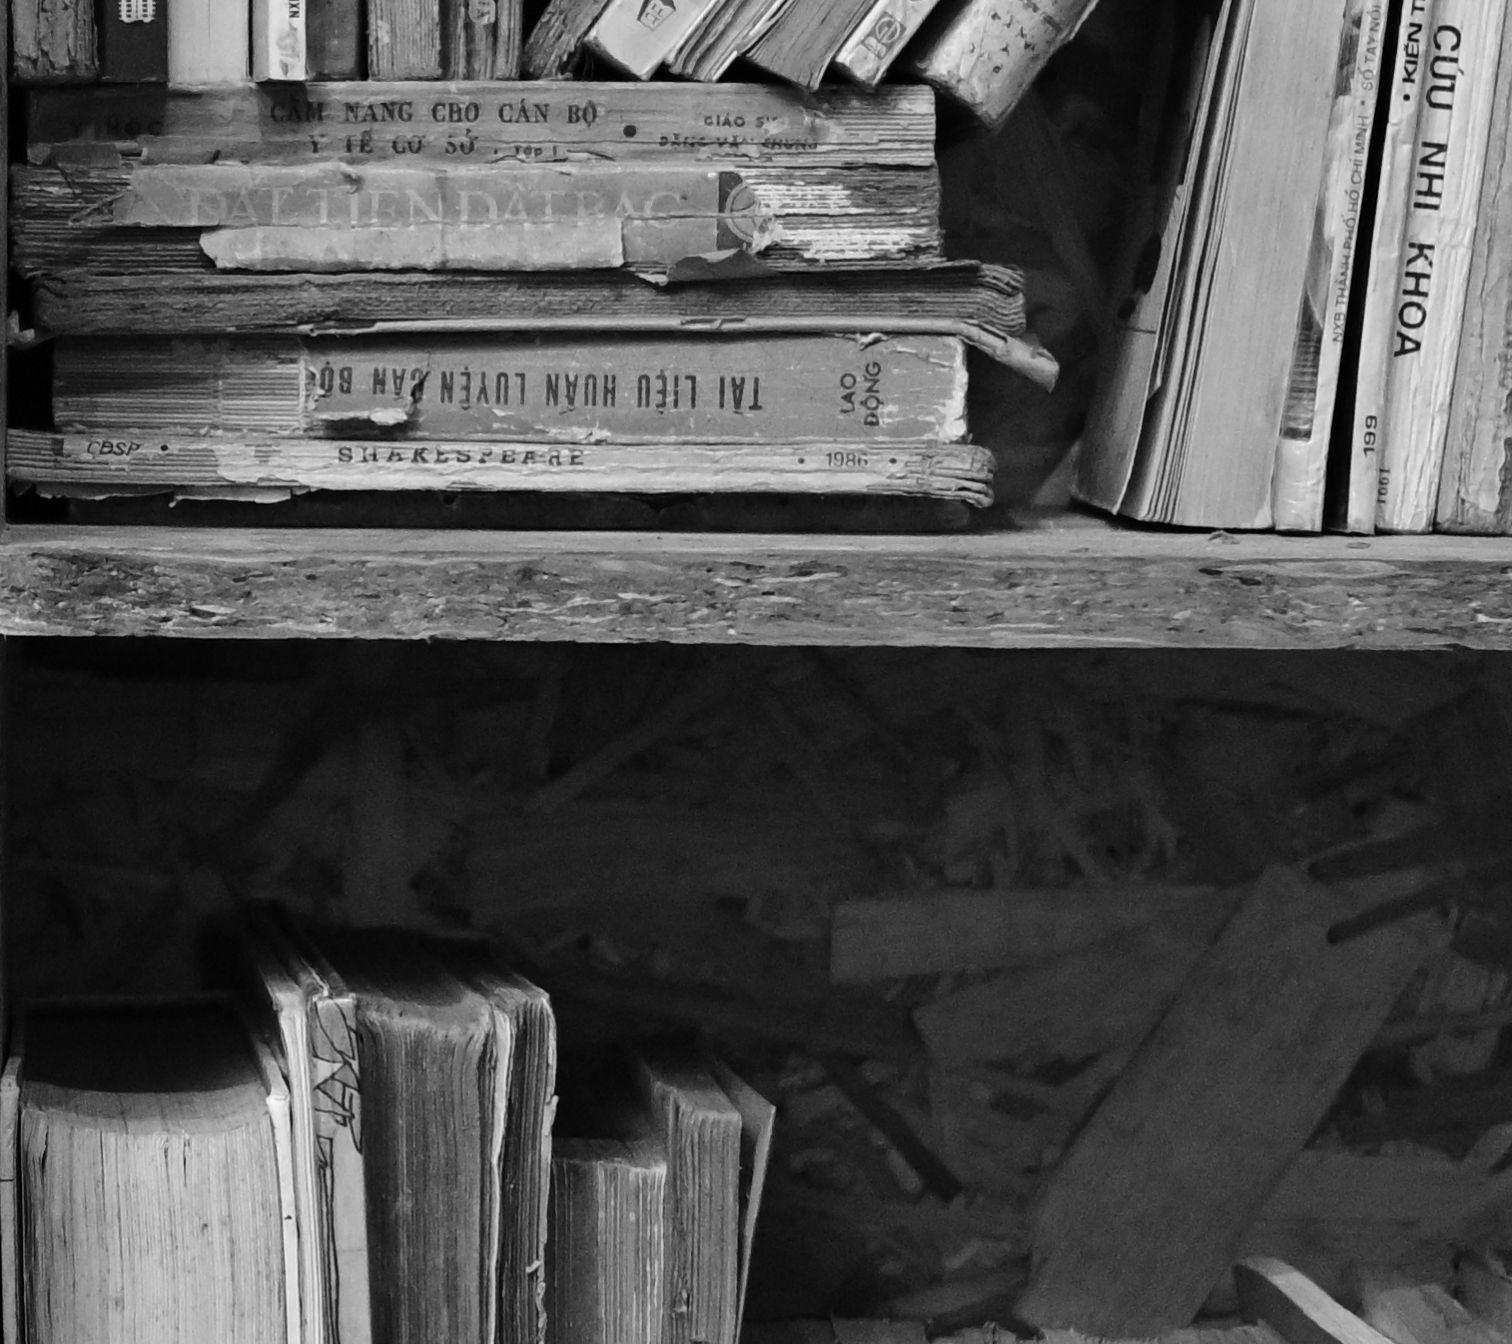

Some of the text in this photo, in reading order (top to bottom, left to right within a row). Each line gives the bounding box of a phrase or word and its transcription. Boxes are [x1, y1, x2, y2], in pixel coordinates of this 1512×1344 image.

[1402, 22, 1423, 84] KIẾN
[1422, 22, 1470, 113] CỨU
[1409, 139, 1448, 213] NHI
[1389, 239, 1436, 362] KHOA
